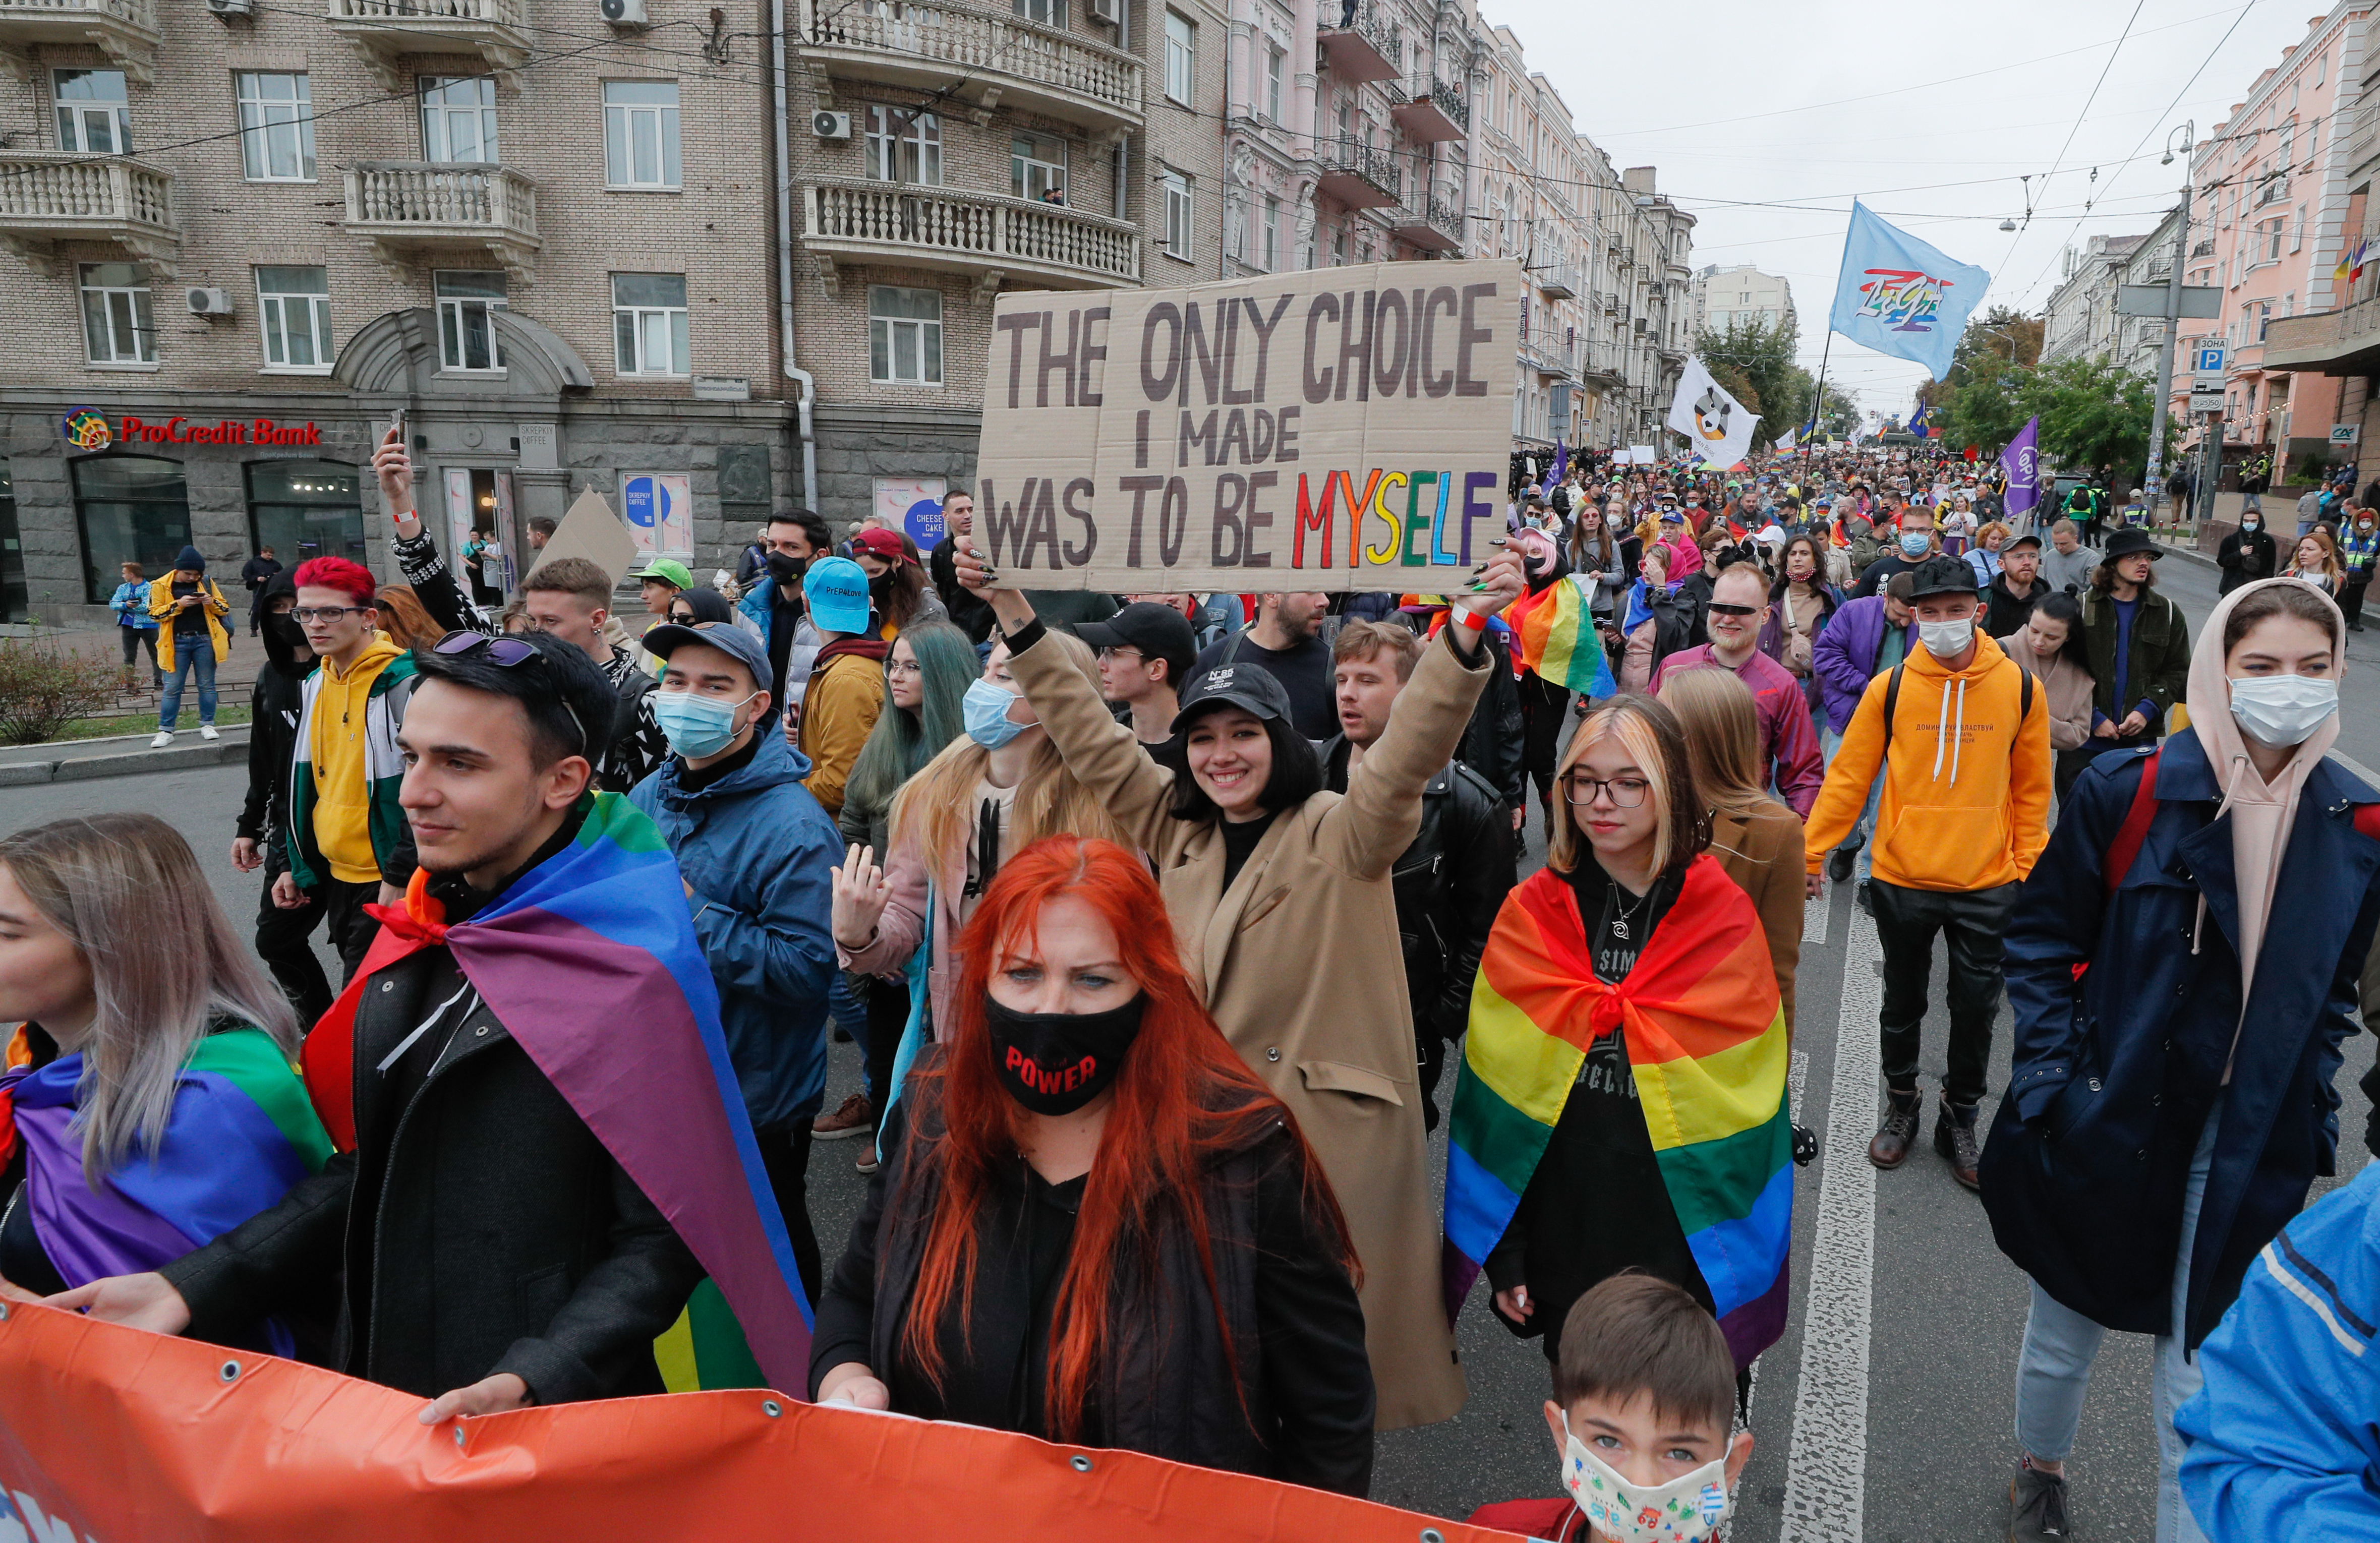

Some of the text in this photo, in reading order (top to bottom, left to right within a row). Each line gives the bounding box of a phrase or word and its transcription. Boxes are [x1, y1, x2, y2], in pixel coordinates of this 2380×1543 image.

[998, 282, 1497, 408] THE ONLY CHOICE
[2205, 351, 2219, 368] P
[122, 417, 322, 445] ProCredit Bank
[521, 426, 553, 434] SKREPKIY
[1135, 406, 1300, 469] I MADE
[522, 436, 546, 444] COFFEE
[916, 514, 942, 523] CHEESE
[981, 468, 1497, 570] WAS TO BE MYSELF
[925, 523, 943, 532] CAKE
[826, 586, 861, 597] PrEP4Love
[1006, 1045, 1096, 1095] POWER
